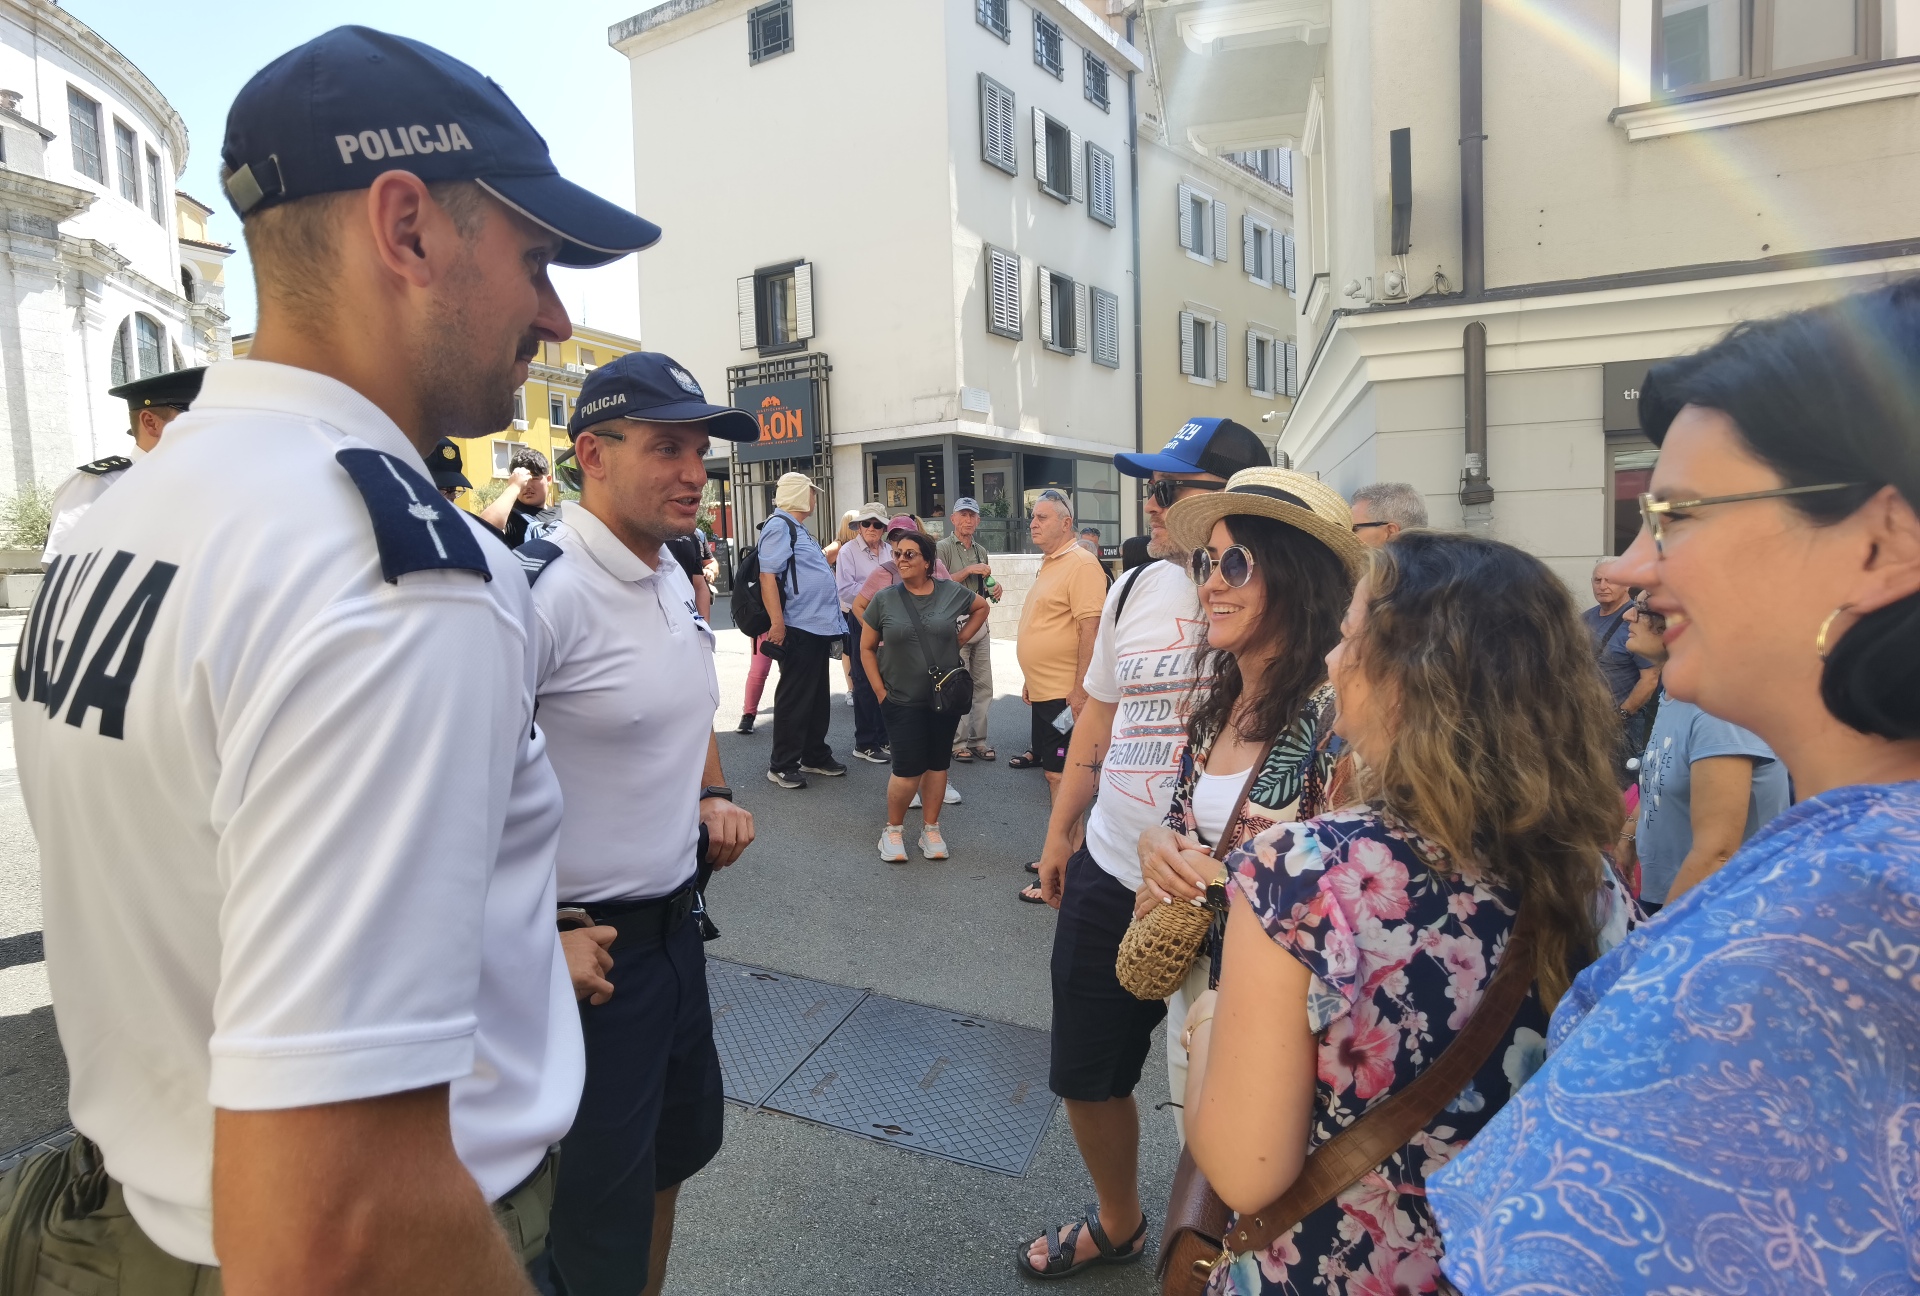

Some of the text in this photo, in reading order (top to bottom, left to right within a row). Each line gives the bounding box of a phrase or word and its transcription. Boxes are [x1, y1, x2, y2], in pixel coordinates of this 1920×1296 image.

[335, 123, 473, 164] POLICJA
[581, 393, 627, 418] POLICJA
[757, 409, 803, 442] LON
[1103, 547, 1118, 556] travel
[1116, 657, 1147, 681] THE
